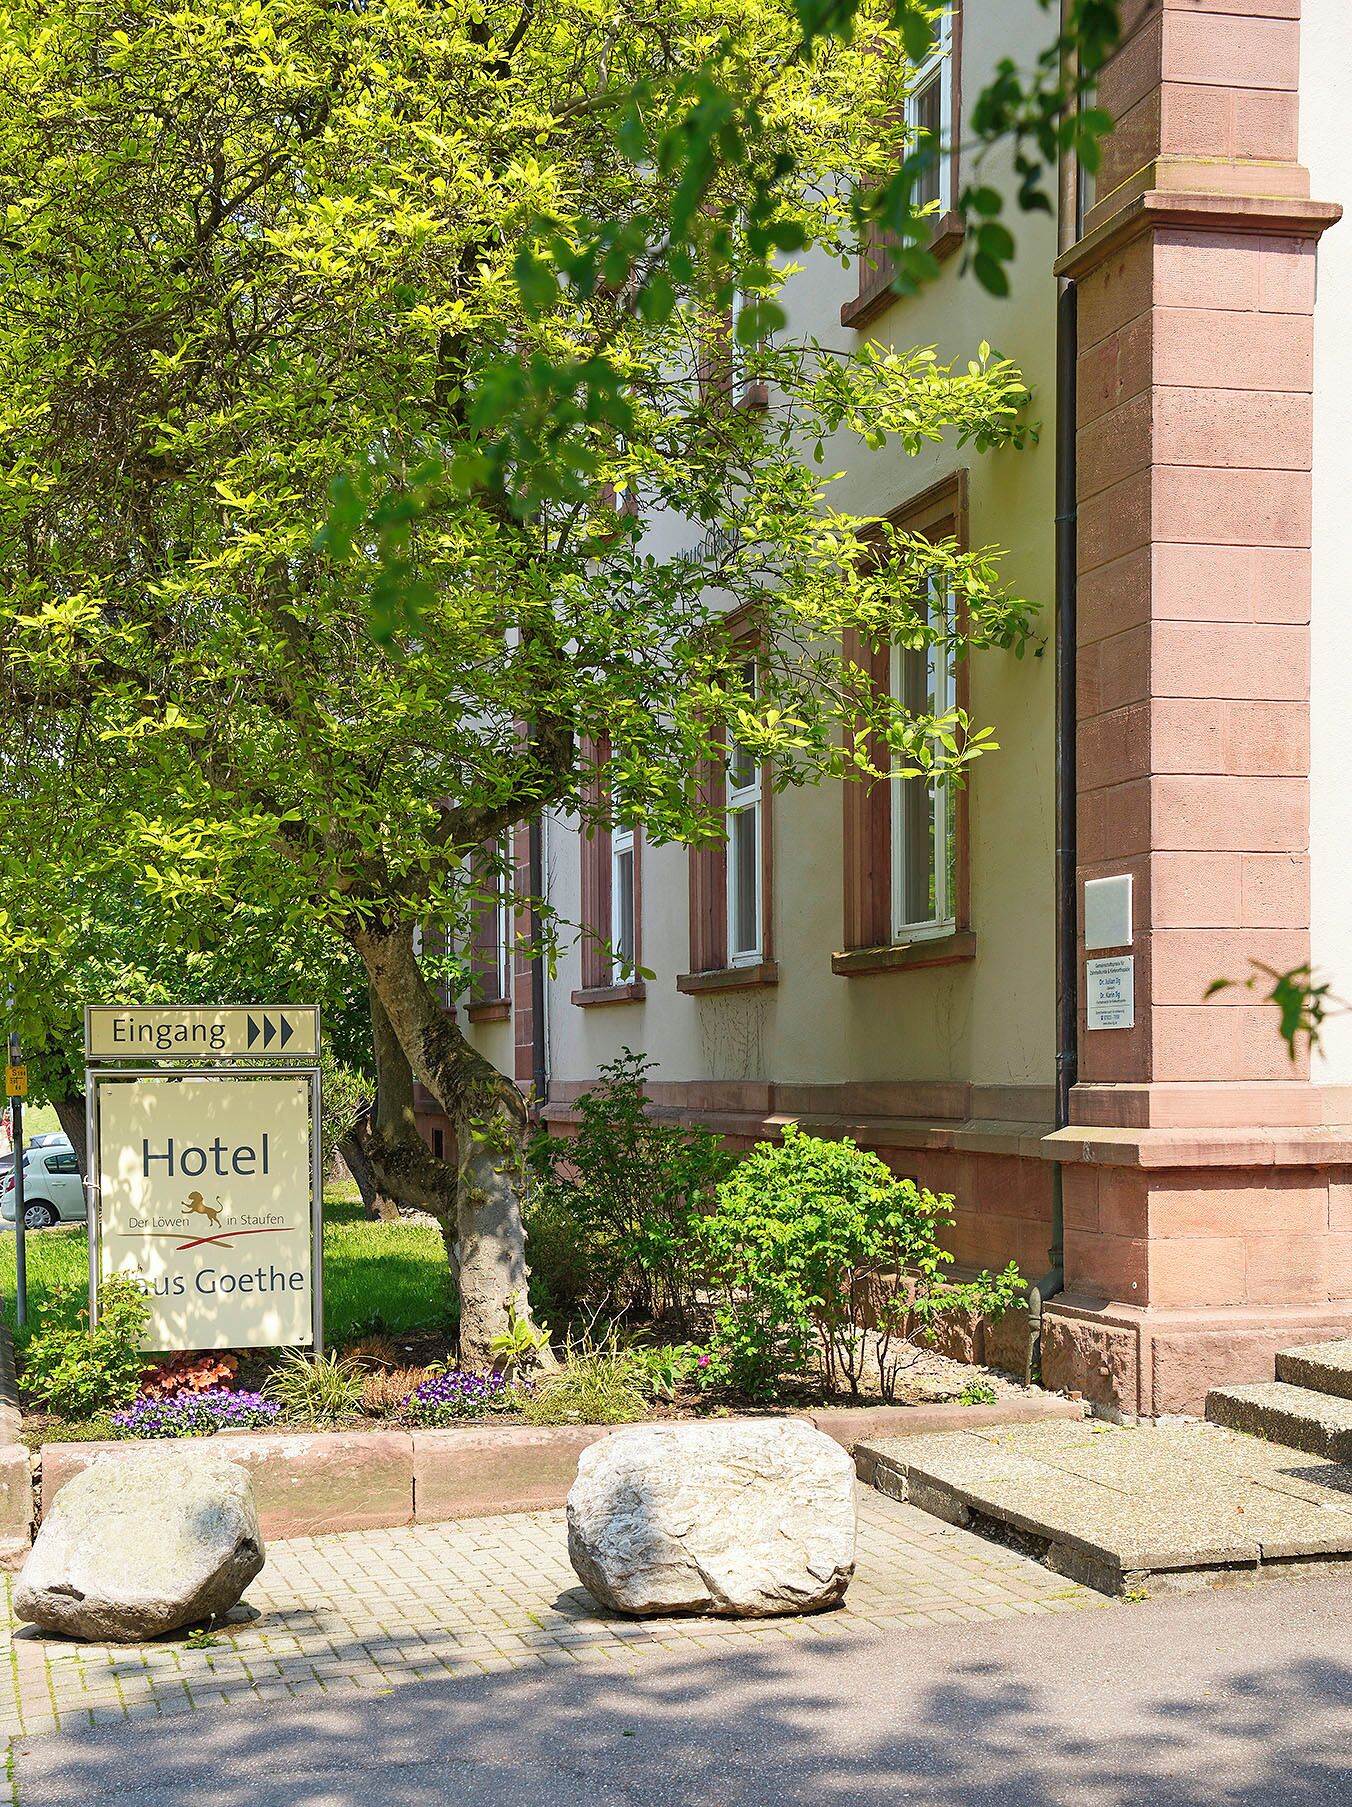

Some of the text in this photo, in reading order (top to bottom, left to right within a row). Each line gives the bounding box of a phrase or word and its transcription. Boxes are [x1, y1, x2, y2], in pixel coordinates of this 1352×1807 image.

[113, 1018, 226, 1050] Eingang
[143, 1133, 269, 1177] Hotel
[129, 1216, 190, 1229] Der Löwen
[227, 1213, 285, 1226] in Staufen
[128, 1265, 304, 1296] aus Goethe
